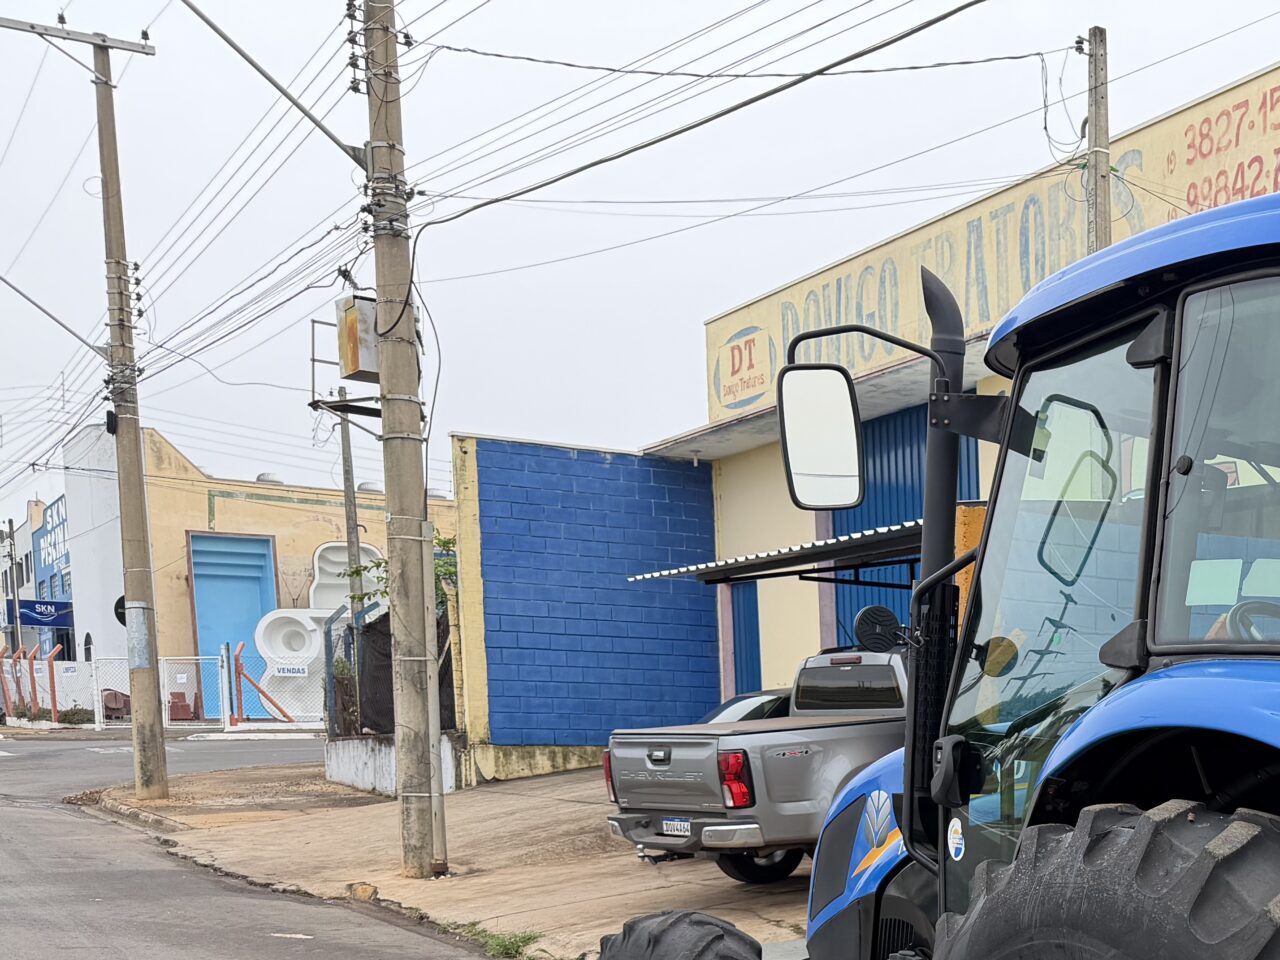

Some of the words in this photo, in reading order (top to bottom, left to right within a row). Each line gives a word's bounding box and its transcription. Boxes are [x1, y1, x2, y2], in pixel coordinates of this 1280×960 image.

[730, 337, 756, 377] DT
[46, 498, 67, 531] SKN
[35, 603, 55, 613] SKN
[277, 667, 306, 675] VENDAS
